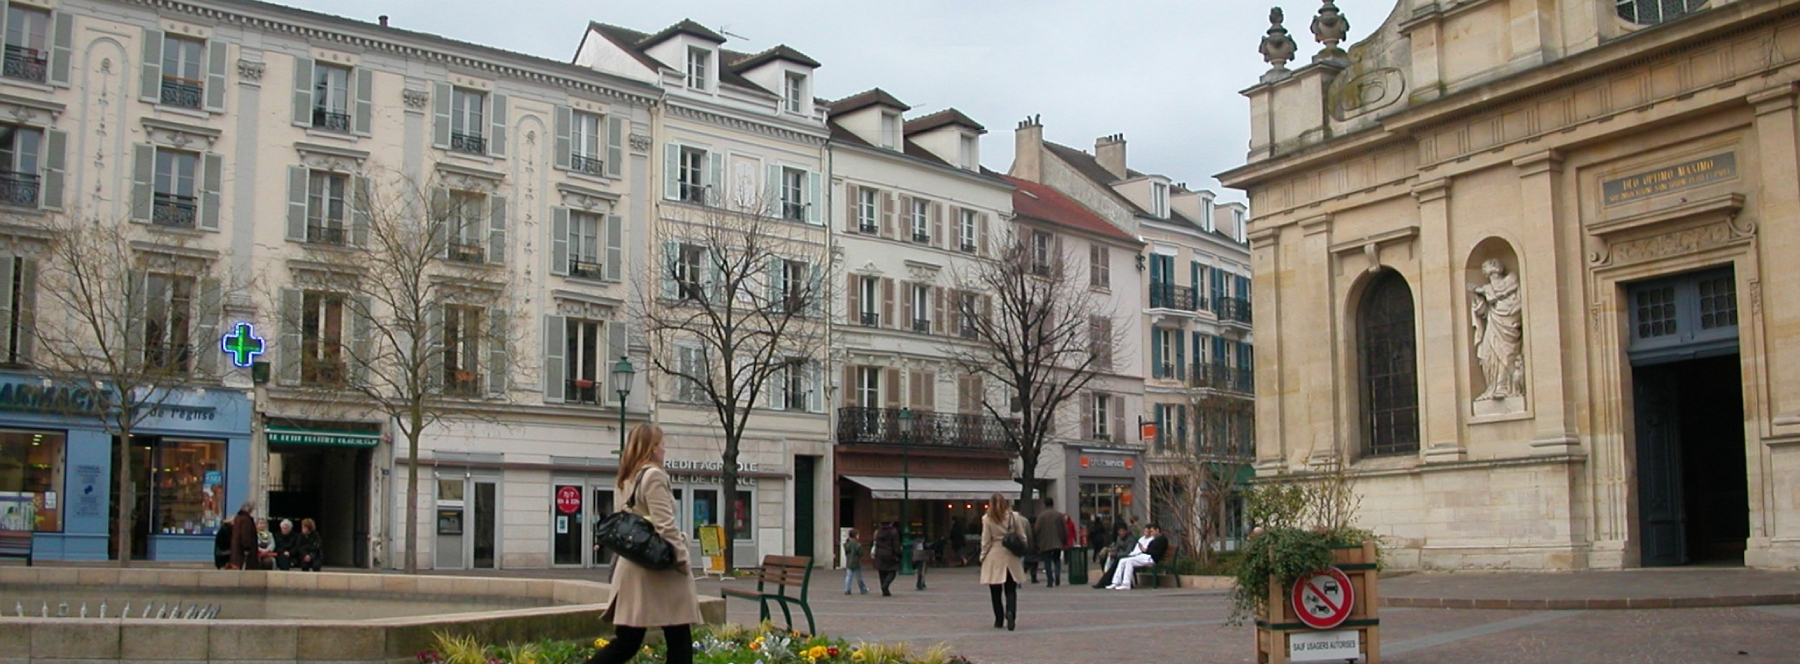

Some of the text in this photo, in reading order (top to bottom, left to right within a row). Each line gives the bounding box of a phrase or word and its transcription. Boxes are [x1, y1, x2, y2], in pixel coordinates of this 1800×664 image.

[663, 459, 758, 472] REDIT AGROLE
[690, 474, 705, 484] DE
[711, 475, 757, 486] FRNCE
[1293, 642, 1305, 651] SAUF
[1306, 641, 1329, 650] USAGERS
